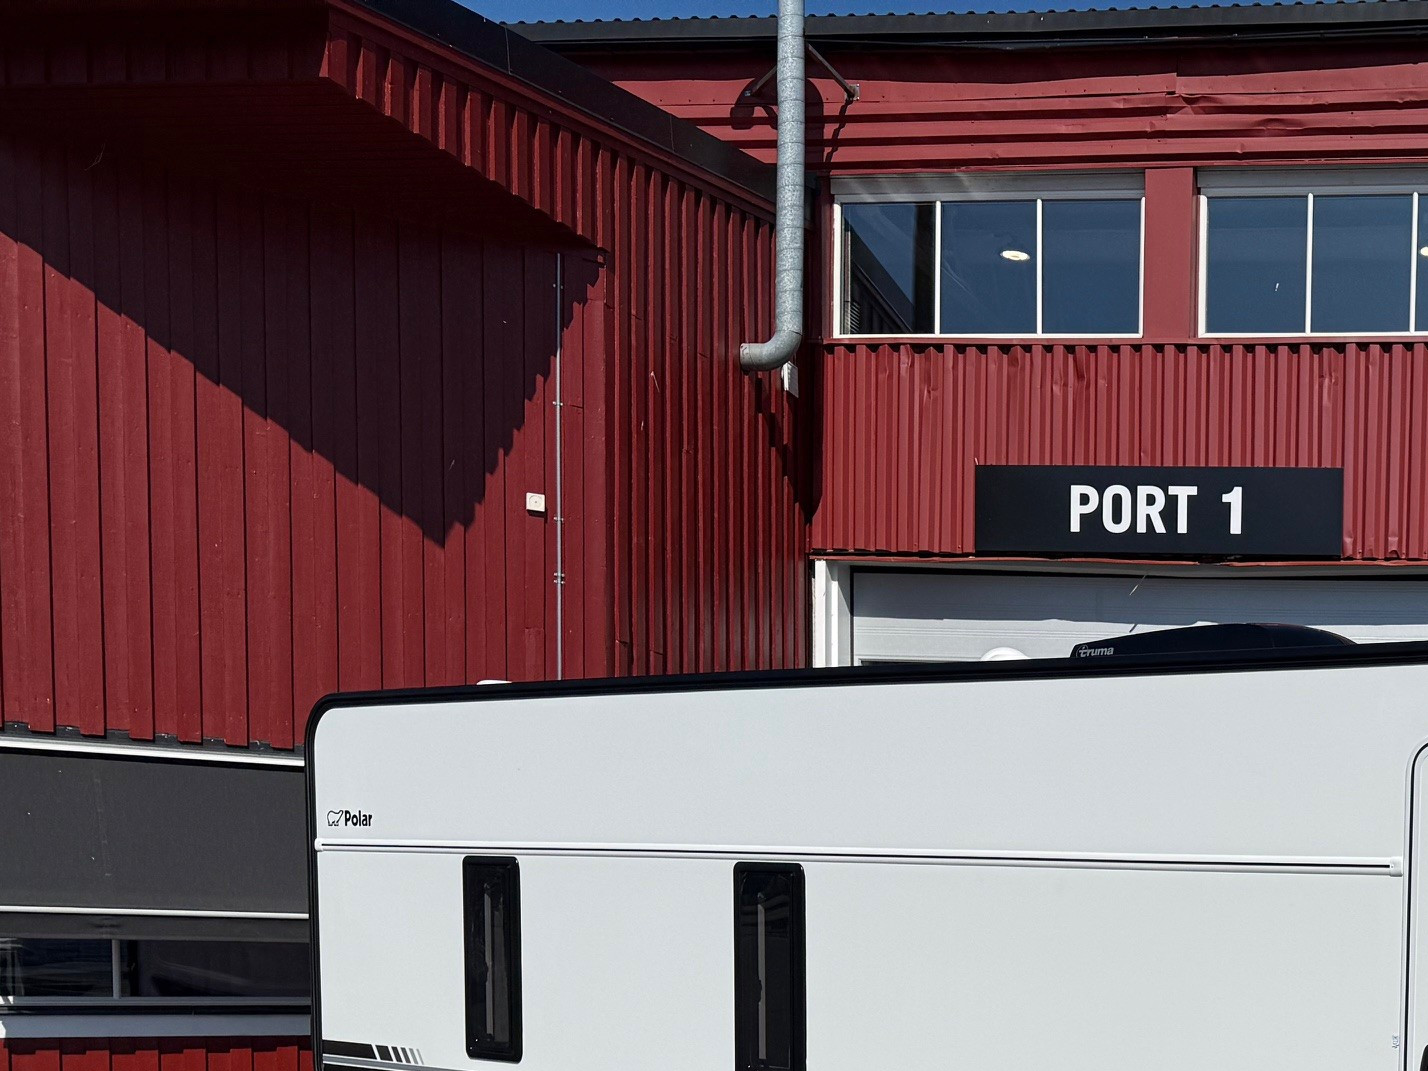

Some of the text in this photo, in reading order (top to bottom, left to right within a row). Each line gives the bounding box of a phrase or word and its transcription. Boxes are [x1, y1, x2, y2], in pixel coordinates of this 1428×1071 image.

[1069, 484, 1243, 535] PORT 1
[344, 809, 373, 827] Polar
